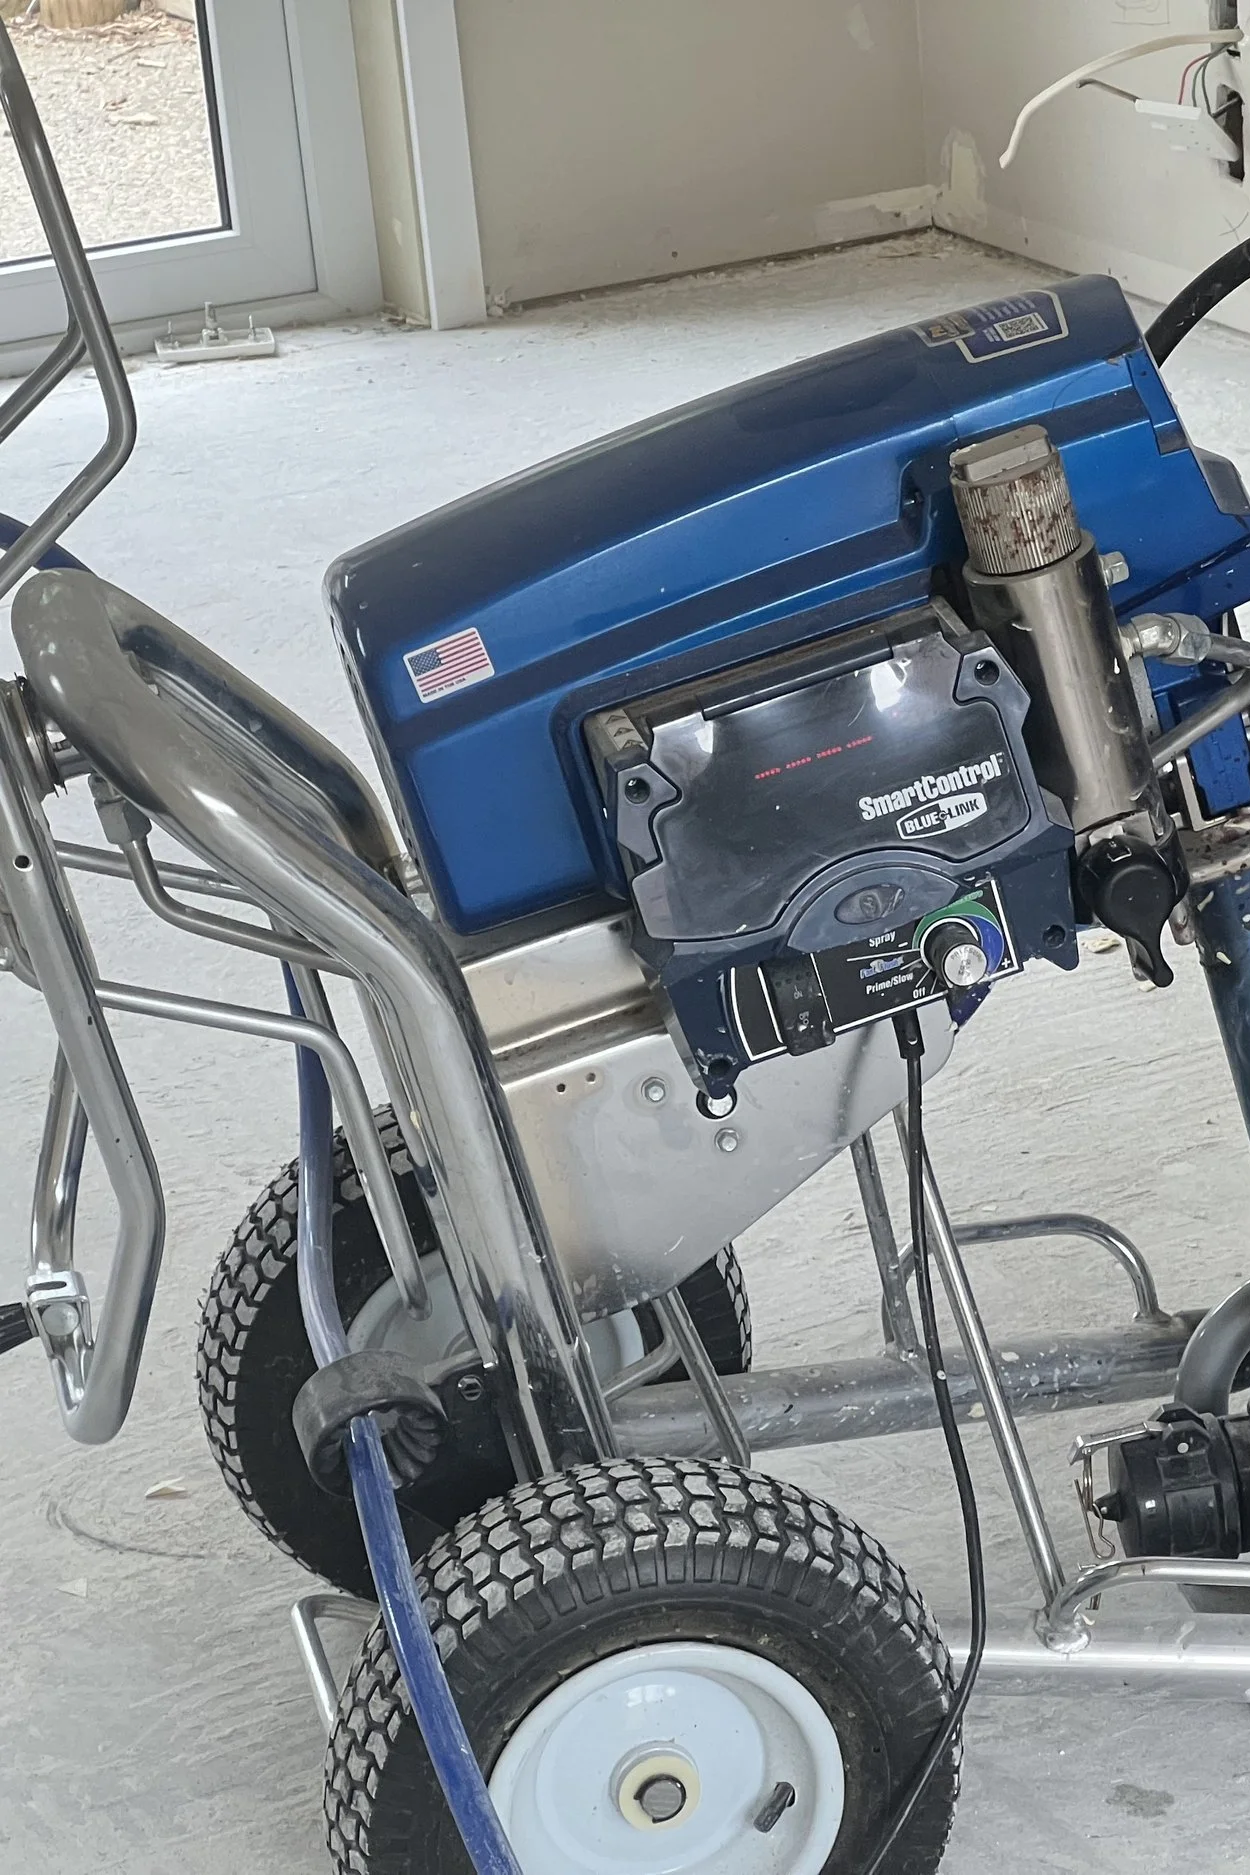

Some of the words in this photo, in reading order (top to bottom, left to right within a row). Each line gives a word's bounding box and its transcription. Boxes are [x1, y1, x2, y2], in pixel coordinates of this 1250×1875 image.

[869, 931, 896, 948] Spray
[866, 972, 914, 995] Prime/Slow
[912, 987, 926, 999] Off
